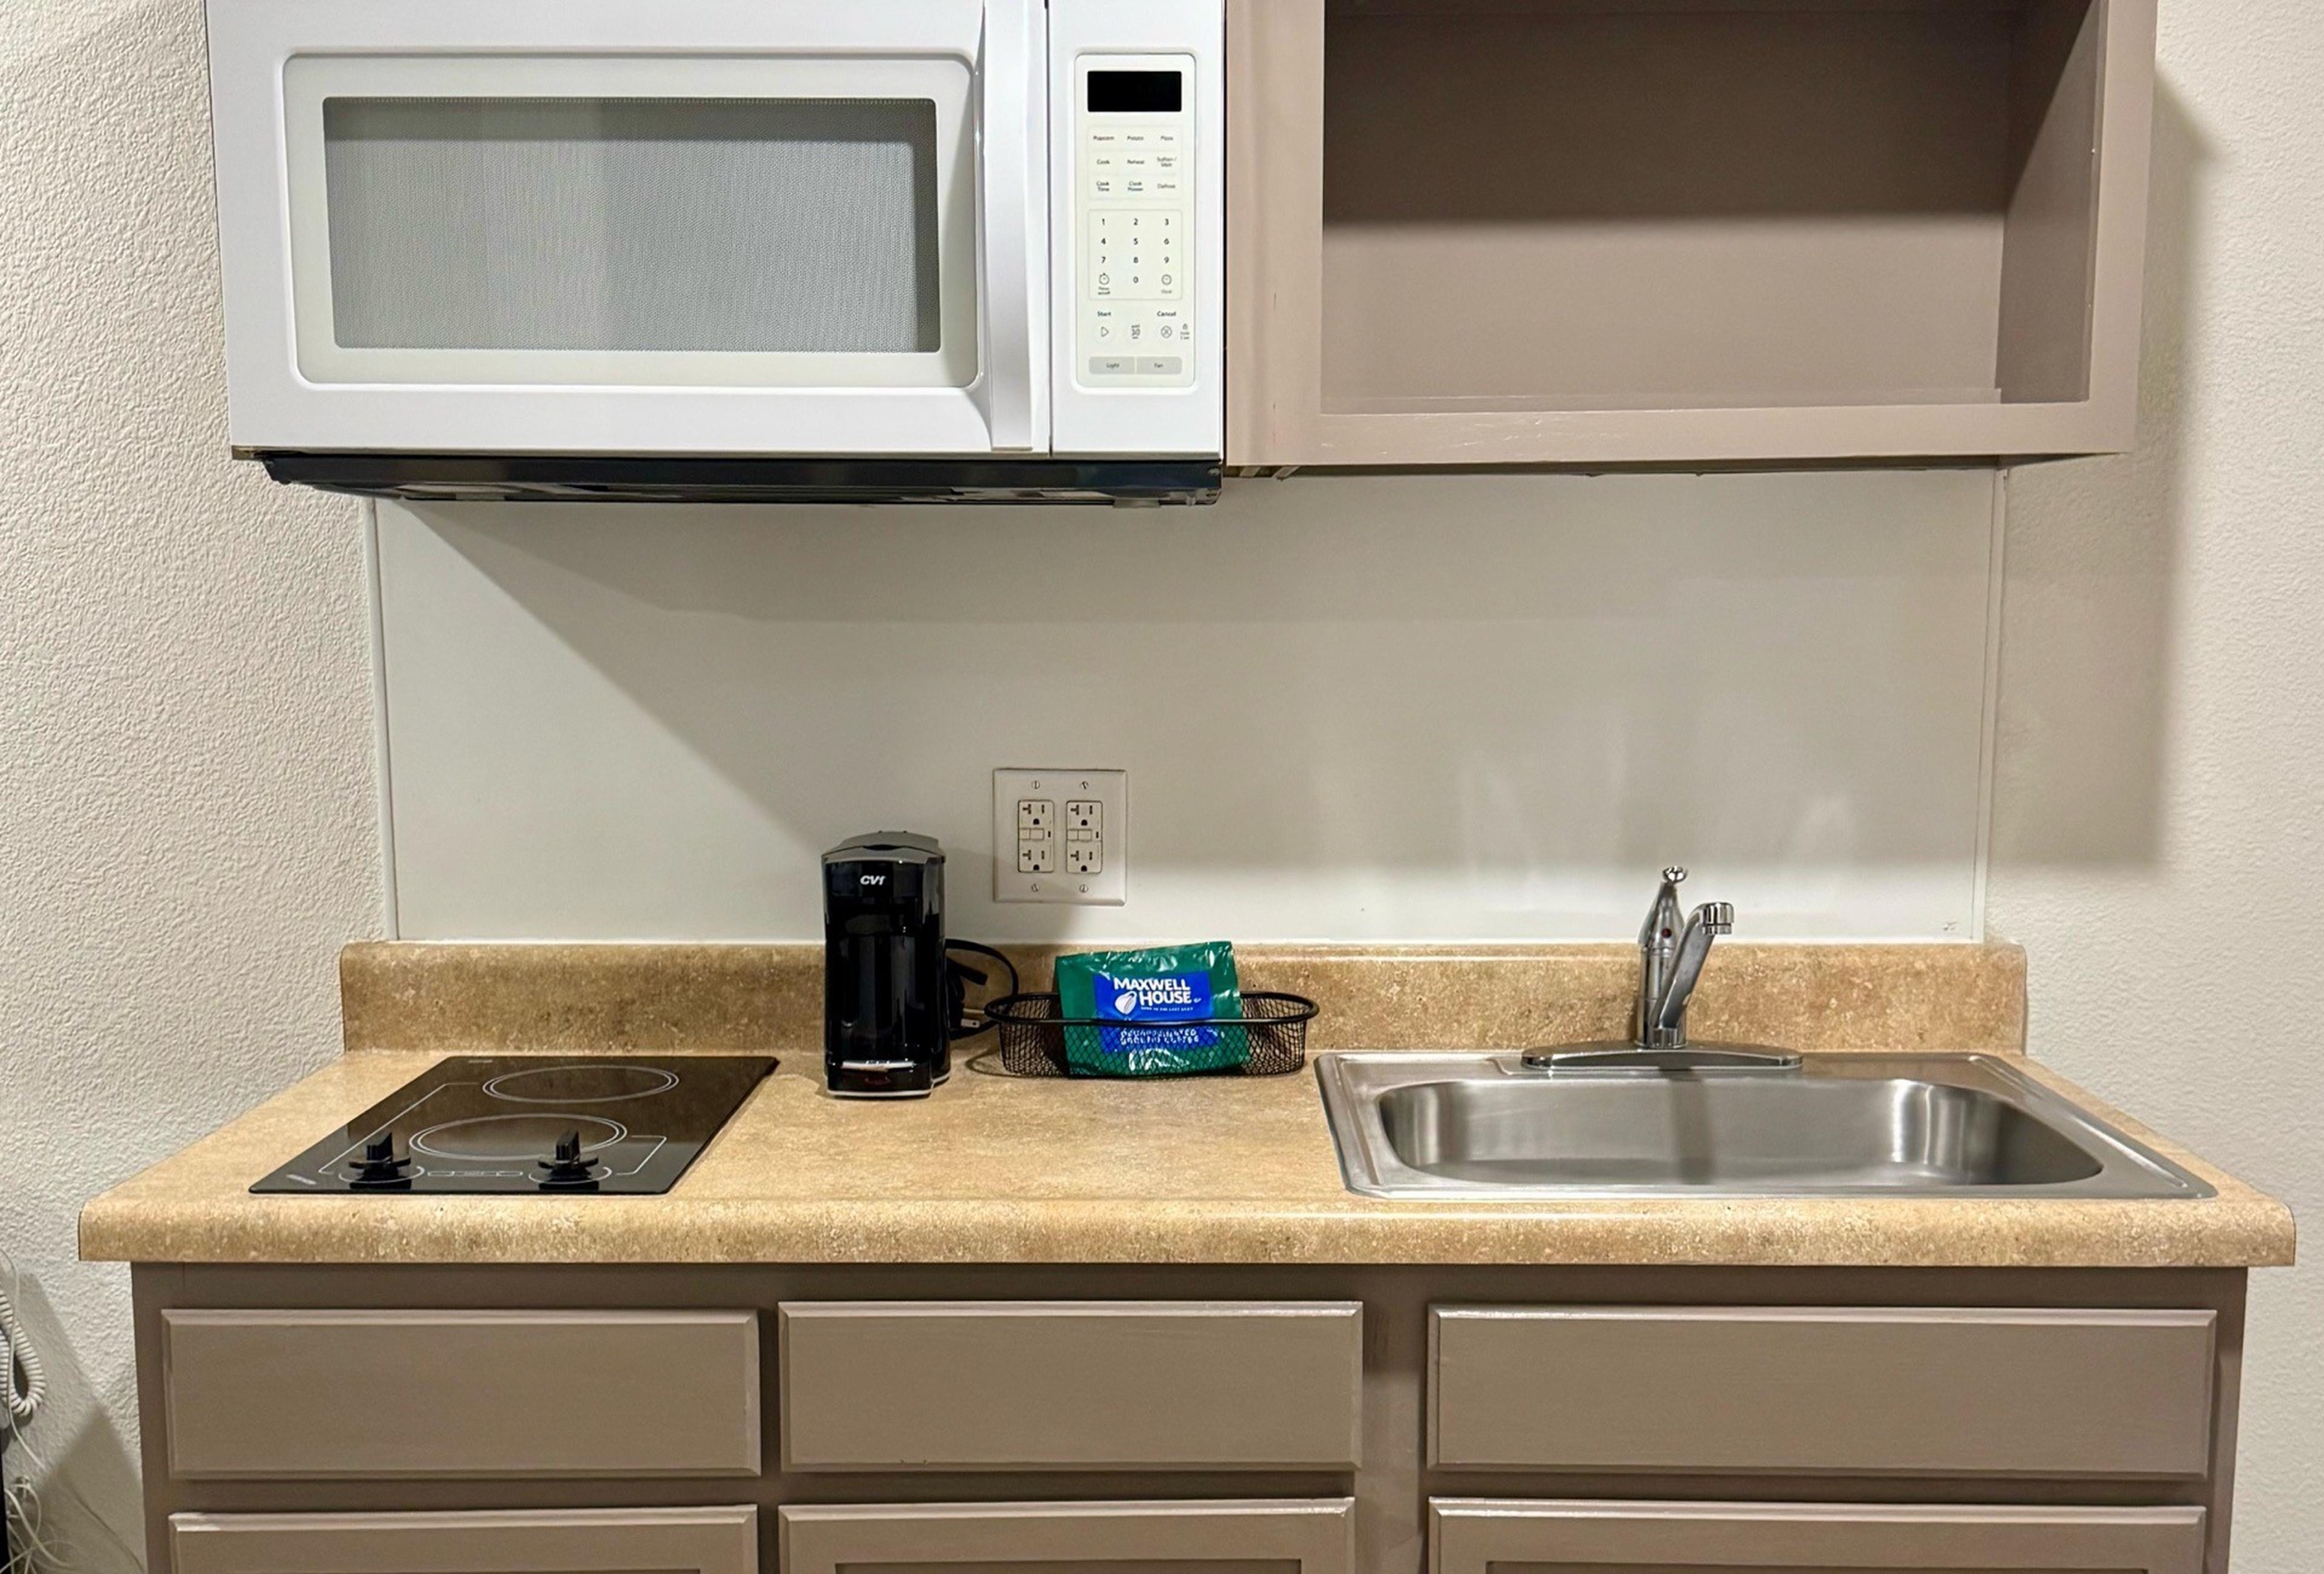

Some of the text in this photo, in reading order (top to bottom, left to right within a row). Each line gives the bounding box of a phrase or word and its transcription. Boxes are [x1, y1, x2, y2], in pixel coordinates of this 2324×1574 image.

[1133, 217, 1139, 226] 2
[1164, 218, 1169, 226] 3
[1133, 237, 1139, 246] 5
[1101, 256, 1107, 264] 7
[1163, 256, 1170, 264] 9
[1132, 276, 1140, 284] 0
[1113, 977, 1190, 990] MAXWELL
[1140, 991, 1192, 1006] HOUSE
